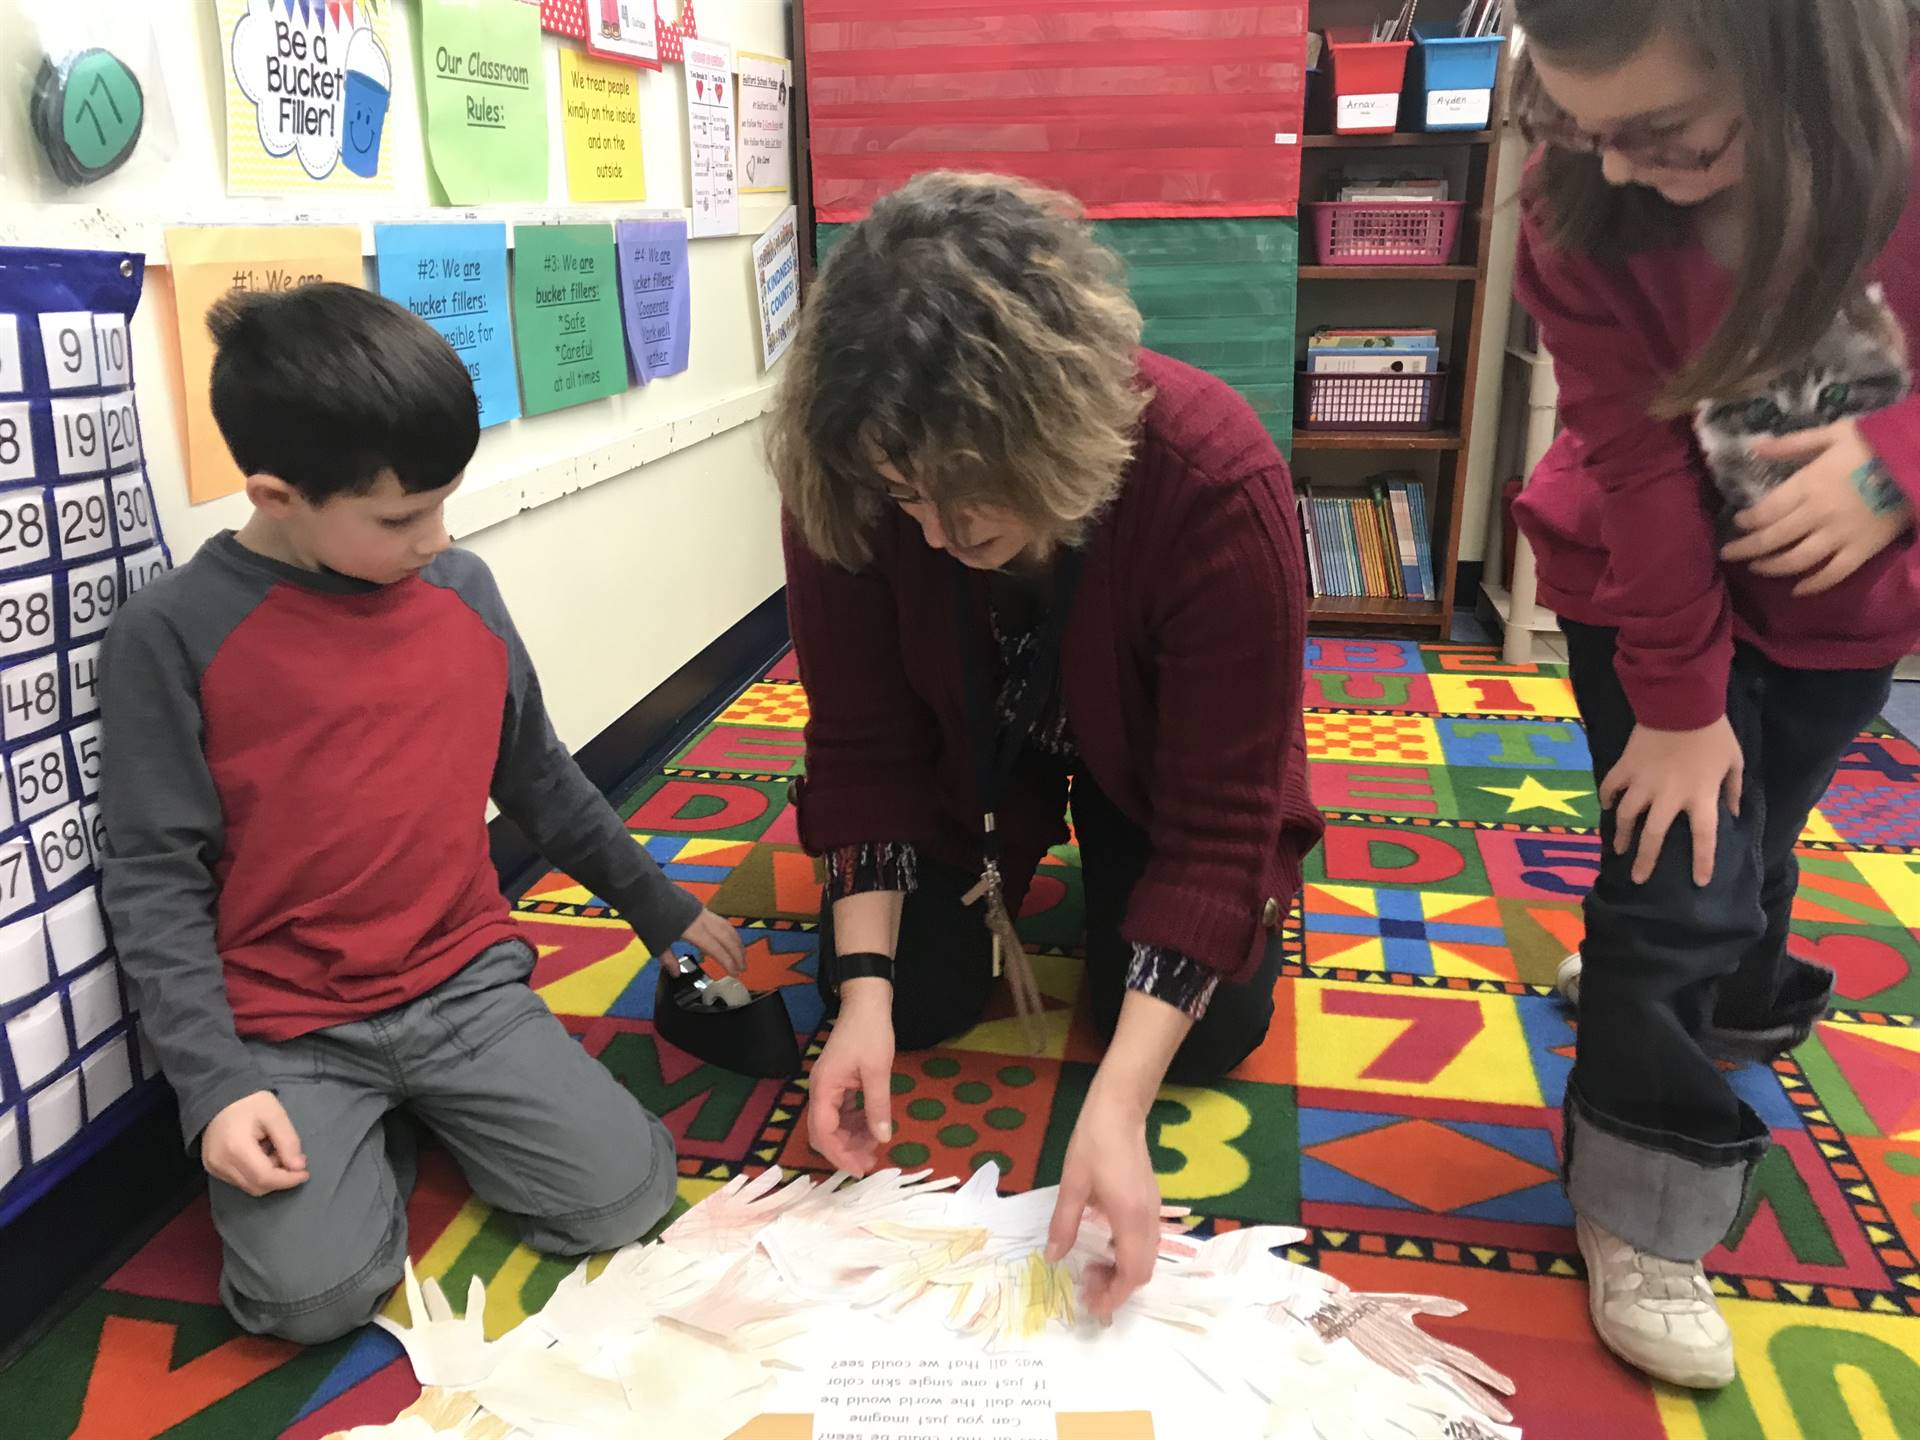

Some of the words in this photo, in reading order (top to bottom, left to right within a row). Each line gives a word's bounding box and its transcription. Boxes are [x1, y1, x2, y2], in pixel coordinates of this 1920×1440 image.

[275, 20, 307, 61] Be
[313, 35, 328, 65] a
[266, 55, 343, 101] Bucket
[436, 46, 462, 74] Our
[468, 51, 529, 85] Classroom
[571, 70, 584, 89] We
[587, 74, 606, 92] treat
[608, 78, 630, 98] people
[466, 95, 504, 123] Rules:
[567, 99, 590, 124] kindly
[592, 108, 601, 120] on
[602, 104, 614, 122] the
[616, 107, 636, 124] inside
[1346, 100, 1376, 110] Arnav
[1437, 96, 1467, 106] Ayden
[279, 97, 335, 137] Filler!
[588, 133, 602, 149] and
[603, 138, 612, 150] on
[613, 134, 625, 151] the
[596, 163, 623, 178] outside
[544, 255, 560, 272] #3:
[562, 255, 577, 271] We
[580, 257, 594, 270] are
[648, 248, 659, 262] We
[660, 249, 671, 261] are
[265, 269, 292, 291] We
[417, 258, 439, 280] #2:
[442, 258, 460, 279] We
[463, 261, 481, 276] are
[765, 254, 794, 294] KINDNESS
[536, 285, 567, 304] bucket
[570, 282, 600, 300] fillers:
[634, 274, 651, 290] ucket
[408, 294, 447, 316] bucket
[451, 290, 487, 312] fillers:
[446, 326, 476, 347] nsible
[478, 322, 494, 342] for
[58, 328, 82, 373] 9
[101, 328, 124, 371] 10
[554, 375, 563, 393] at
[566, 371, 576, 390] all
[578, 370, 601, 387] times
[0, 418, 20, 465] 8
[63, 413, 96, 458] 19
[107, 406, 135, 453] 20
[61, 495, 106, 545] 29
[117, 486, 148, 532] 30
[0, 503, 43, 554] 28
[73, 575, 115, 624] 39
[0, 592, 50, 643] 38
[1311, 639, 1408, 669] B
[74, 658, 99, 697] 4
[1312, 673, 1415, 706] U
[6, 672, 56, 721] 48
[1466, 678, 1536, 712] 1
[1452, 722, 1574, 765] T
[79, 736, 101, 779] 5
[18, 752, 63, 804] 58
[1309, 762, 1439, 814] E
[624, 779, 770, 832] D
[92, 813, 108, 853] 6
[40, 818, 84, 874] 68
[1325, 827, 1466, 885] D
[0, 851, 22, 899] 7
[1514, 837, 1601, 897] 5
[1320, 986, 1486, 1085] 7
[1152, 1087, 1253, 1200] 3
[830, 1358, 865, 1370] see?
[870, 1358, 912, 1370] could
[918, 1359, 940, 1369] we
[948, 1358, 980, 1370] that
[989, 1357, 1008, 1370] all
[1015, 1358, 1045, 1369] was
[826, 1375, 865, 1387] color
[871, 1376, 902, 1387] skin
[908, 1375, 954, 1388] single
[960, 1378, 988, 1388] one
[995, 1377, 1024, 1390] just
[1034, 1378, 1047, 1390] If
[820, 1394, 840, 1405] be
[846, 1394, 892, 1405] would
[898, 1395, 943, 1406] world
[950, 1397, 976, 1408] the
[985, 1397, 1015, 1408] dull
[1020, 1398, 1052, 1409] how
[849, 1411, 910, 1425] imagine
[917, 1413, 949, 1425] just
[957, 1413, 985, 1425] you
[992, 1416, 1021, 1427] Can
